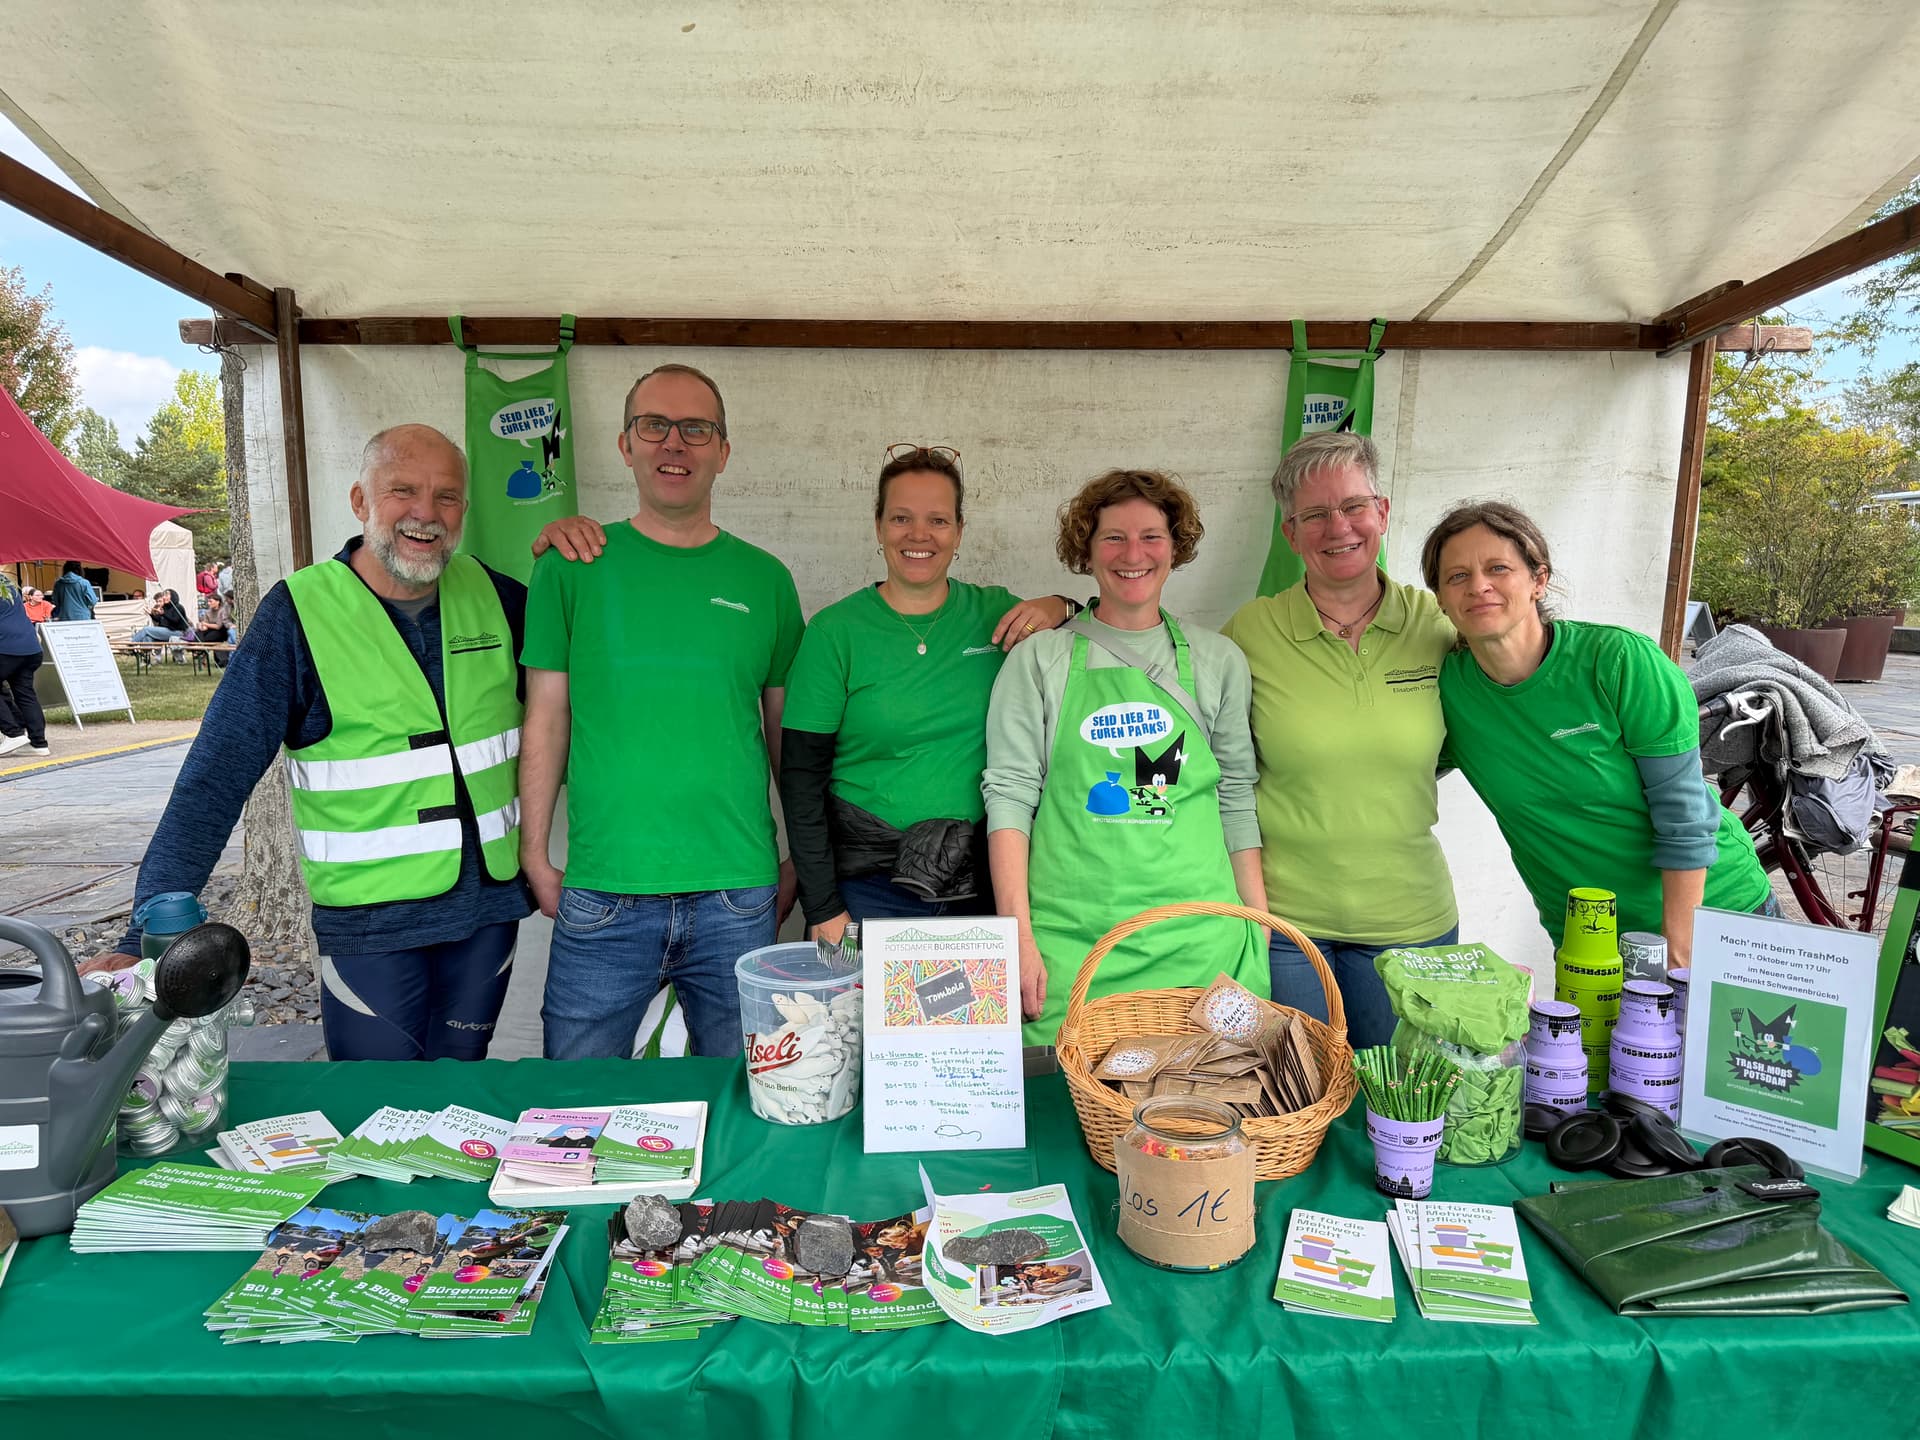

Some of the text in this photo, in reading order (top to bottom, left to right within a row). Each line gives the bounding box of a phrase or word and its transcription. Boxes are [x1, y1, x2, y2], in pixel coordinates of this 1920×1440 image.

[1310, 402, 1329, 413] LIEB
[1332, 400, 1343, 410] ZU
[499, 411, 522, 424] SEID
[524, 406, 545, 419] LIEB
[500, 421, 531, 435] EUREN
[1092, 709, 1160, 726] SEID LIEB ZU
[1090, 721, 1167, 740] EUREN PARKS!
[934, 942, 1004, 951] BÜRGERSTIFTUNG
[1751, 942, 1768, 950] mit
[1770, 944, 1795, 955] beim
[1797, 948, 1849, 965] TrashMob
[1446, 949, 1485, 962] Dich
[1404, 959, 1485, 971] nicht auf,
[1564, 964, 1620, 976] POTSPRESSO
[1757, 955, 1788, 966] Oktober
[1816, 966, 1831, 974] Uhr
[1760, 968, 1785, 979] Neuen
[1786, 974, 1814, 984] Garten
[926, 982, 965, 1004] Tombola
[1723, 972, 1839, 1001] (Treffpunkt Schwanenbrücke)
[1622, 1047, 1677, 1059] POTSPRESSO
[1743, 1070, 1787, 1088] POTSDAM
[451, 1107, 479, 1120] WAS
[619, 1108, 648, 1117] WAS
[442, 1121, 489, 1138] TRÄGT
[445, 1113, 508, 1136] POTSDAM
[616, 1115, 679, 1130] POTSDAM
[467, 1143, 489, 1155] 15
[643, 1139, 666, 1149] 15
[157, 1167, 243, 1184] Jahresbericht
[147, 1173, 306, 1200] Potsdamer Bürgerstiftung
[368, 1284, 409, 1305] Bürge
[424, 1286, 518, 1296] Bürgermobil
[851, 1301, 938, 1315] Stadtband
